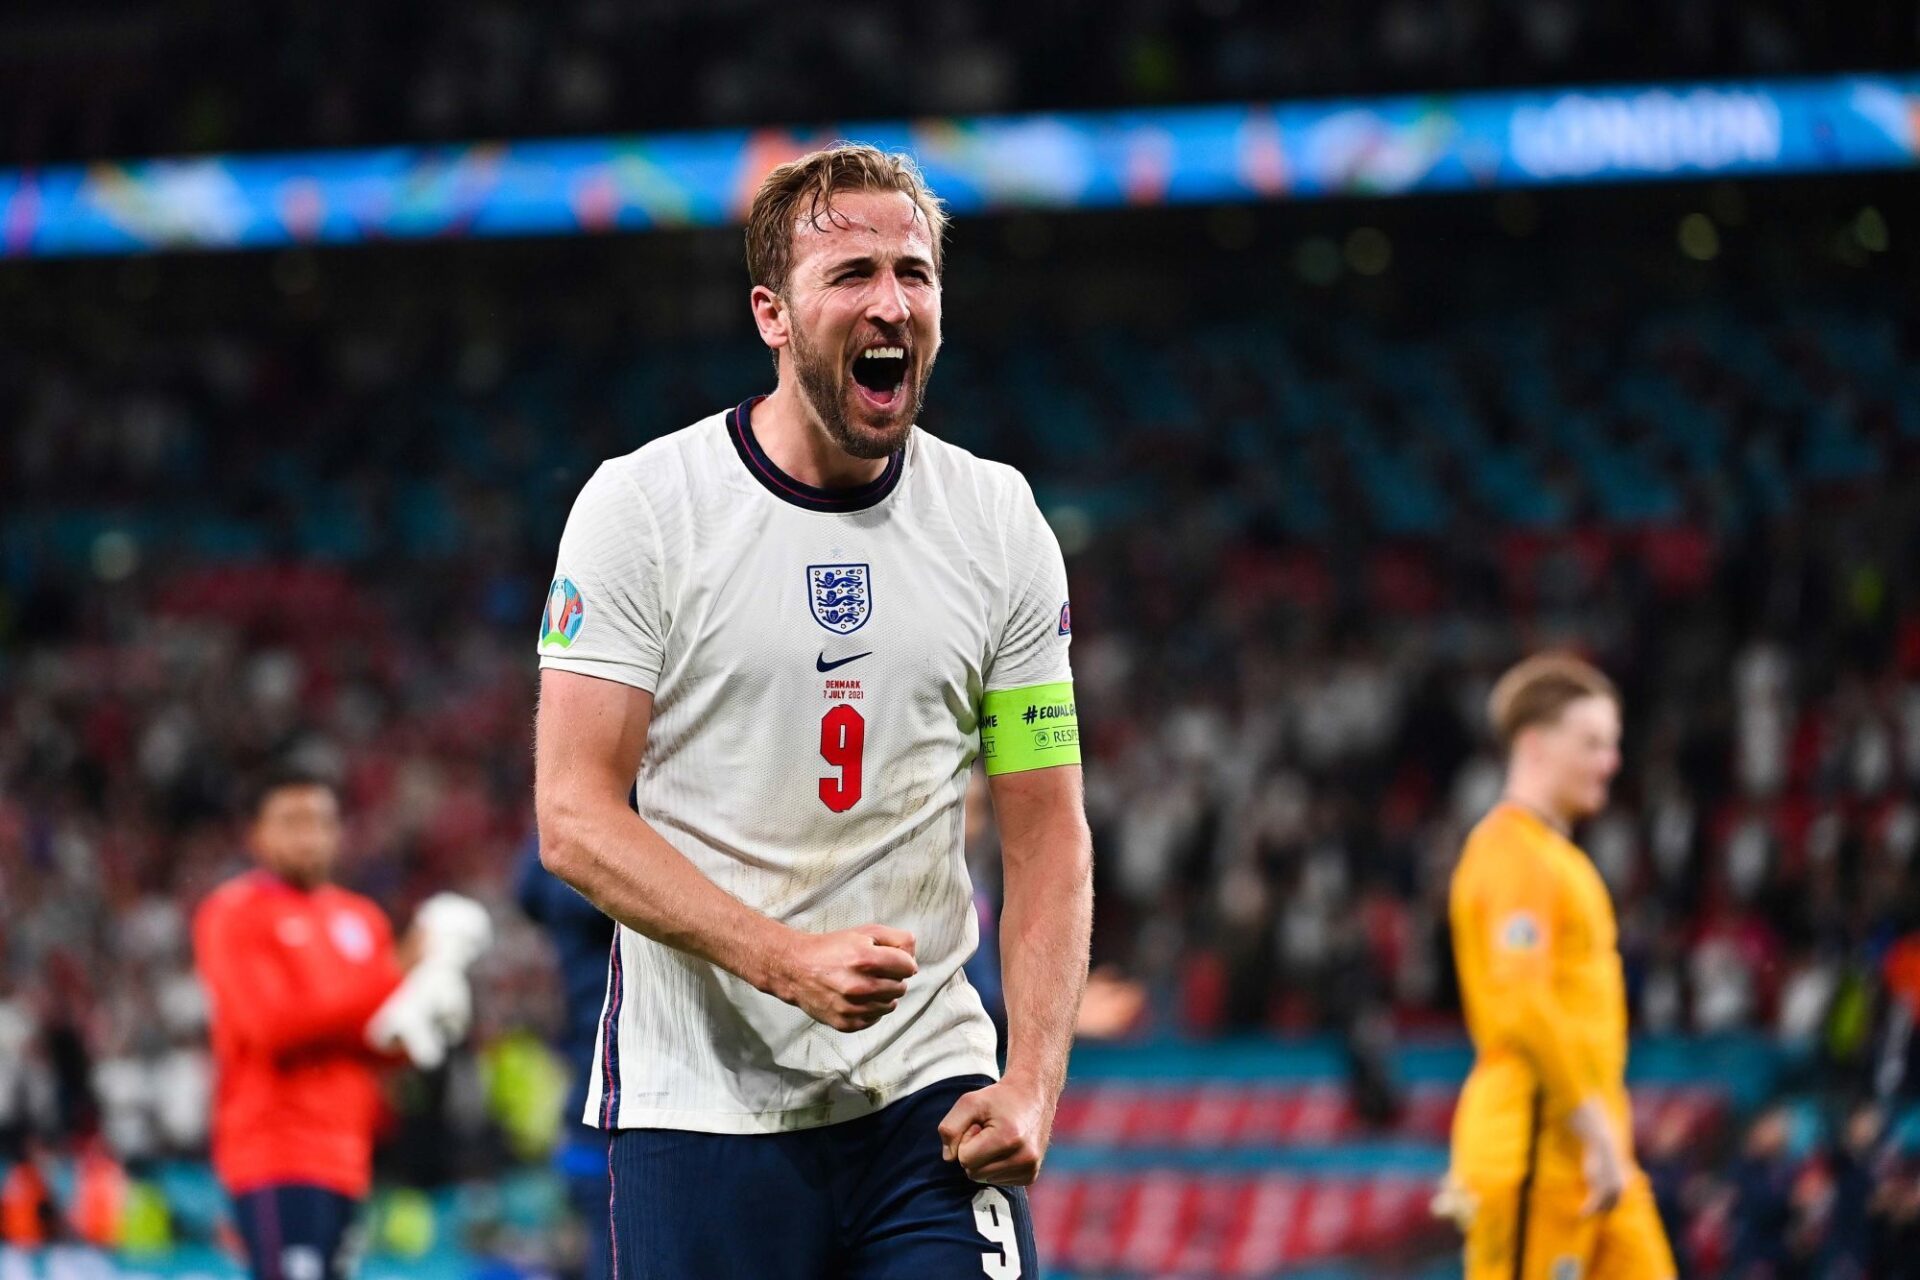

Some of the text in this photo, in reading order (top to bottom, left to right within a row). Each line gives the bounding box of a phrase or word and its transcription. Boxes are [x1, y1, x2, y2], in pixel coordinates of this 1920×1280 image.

[823, 690, 864, 699] 7 JULY 2021
[825, 680, 861, 689] DENMARK
[819, 704, 864, 813] 9
[971, 1186, 1022, 1280] 9
